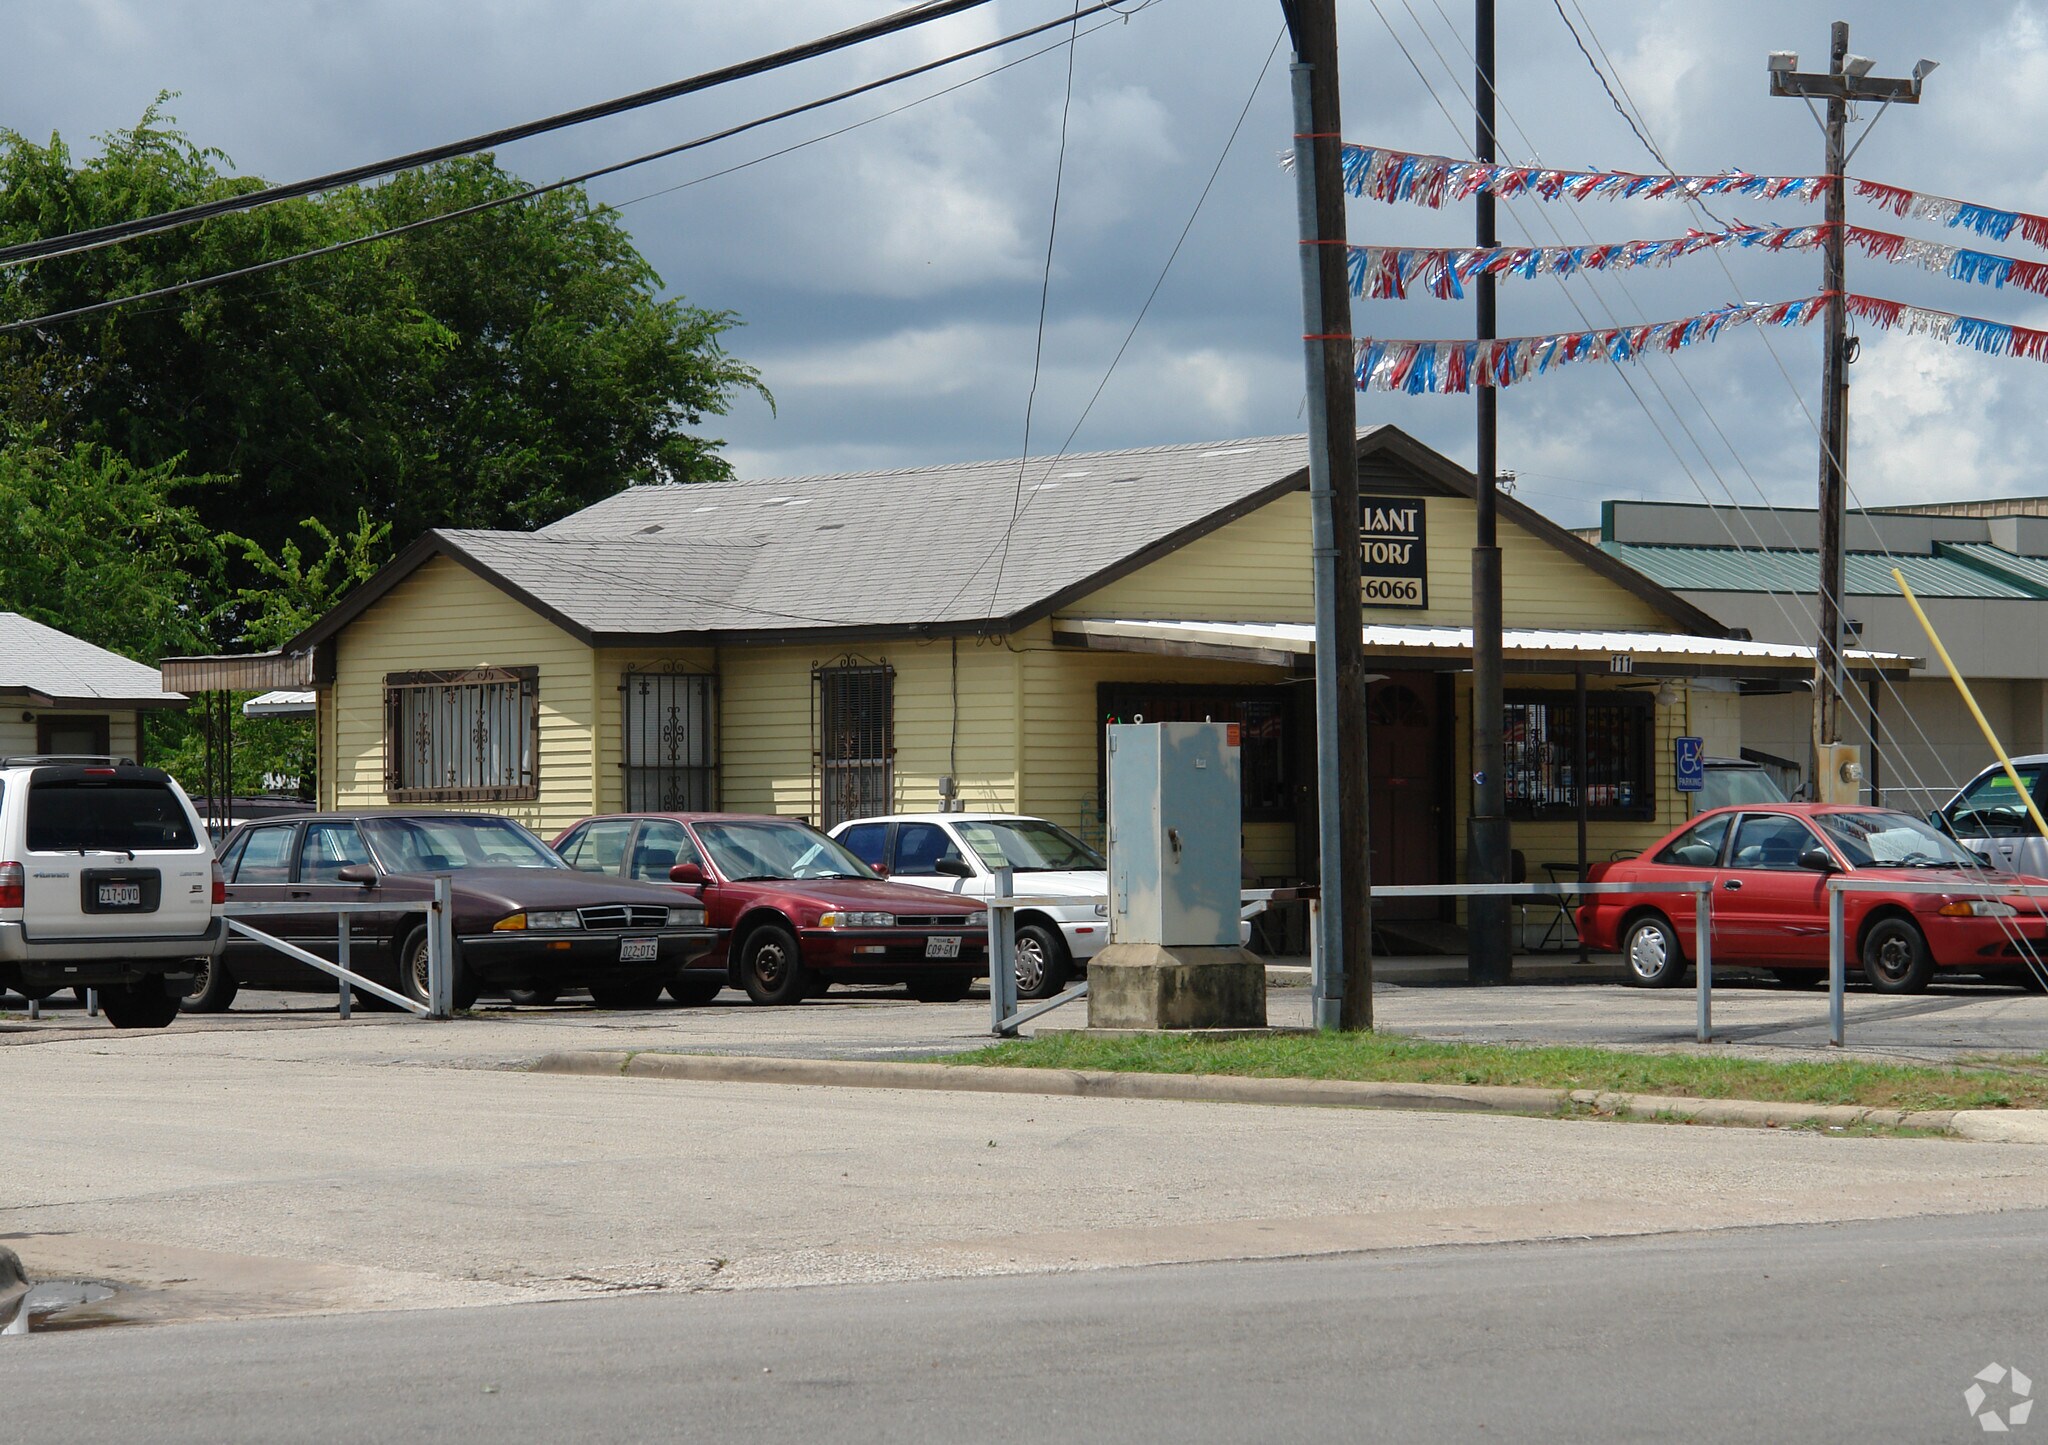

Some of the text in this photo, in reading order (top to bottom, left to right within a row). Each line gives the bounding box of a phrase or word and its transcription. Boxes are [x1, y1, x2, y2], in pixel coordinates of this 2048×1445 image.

[1360, 542, 1413, 565] TORS
[1612, 655, 1631, 673] 111
[1679, 777, 1702, 787] PARKING
